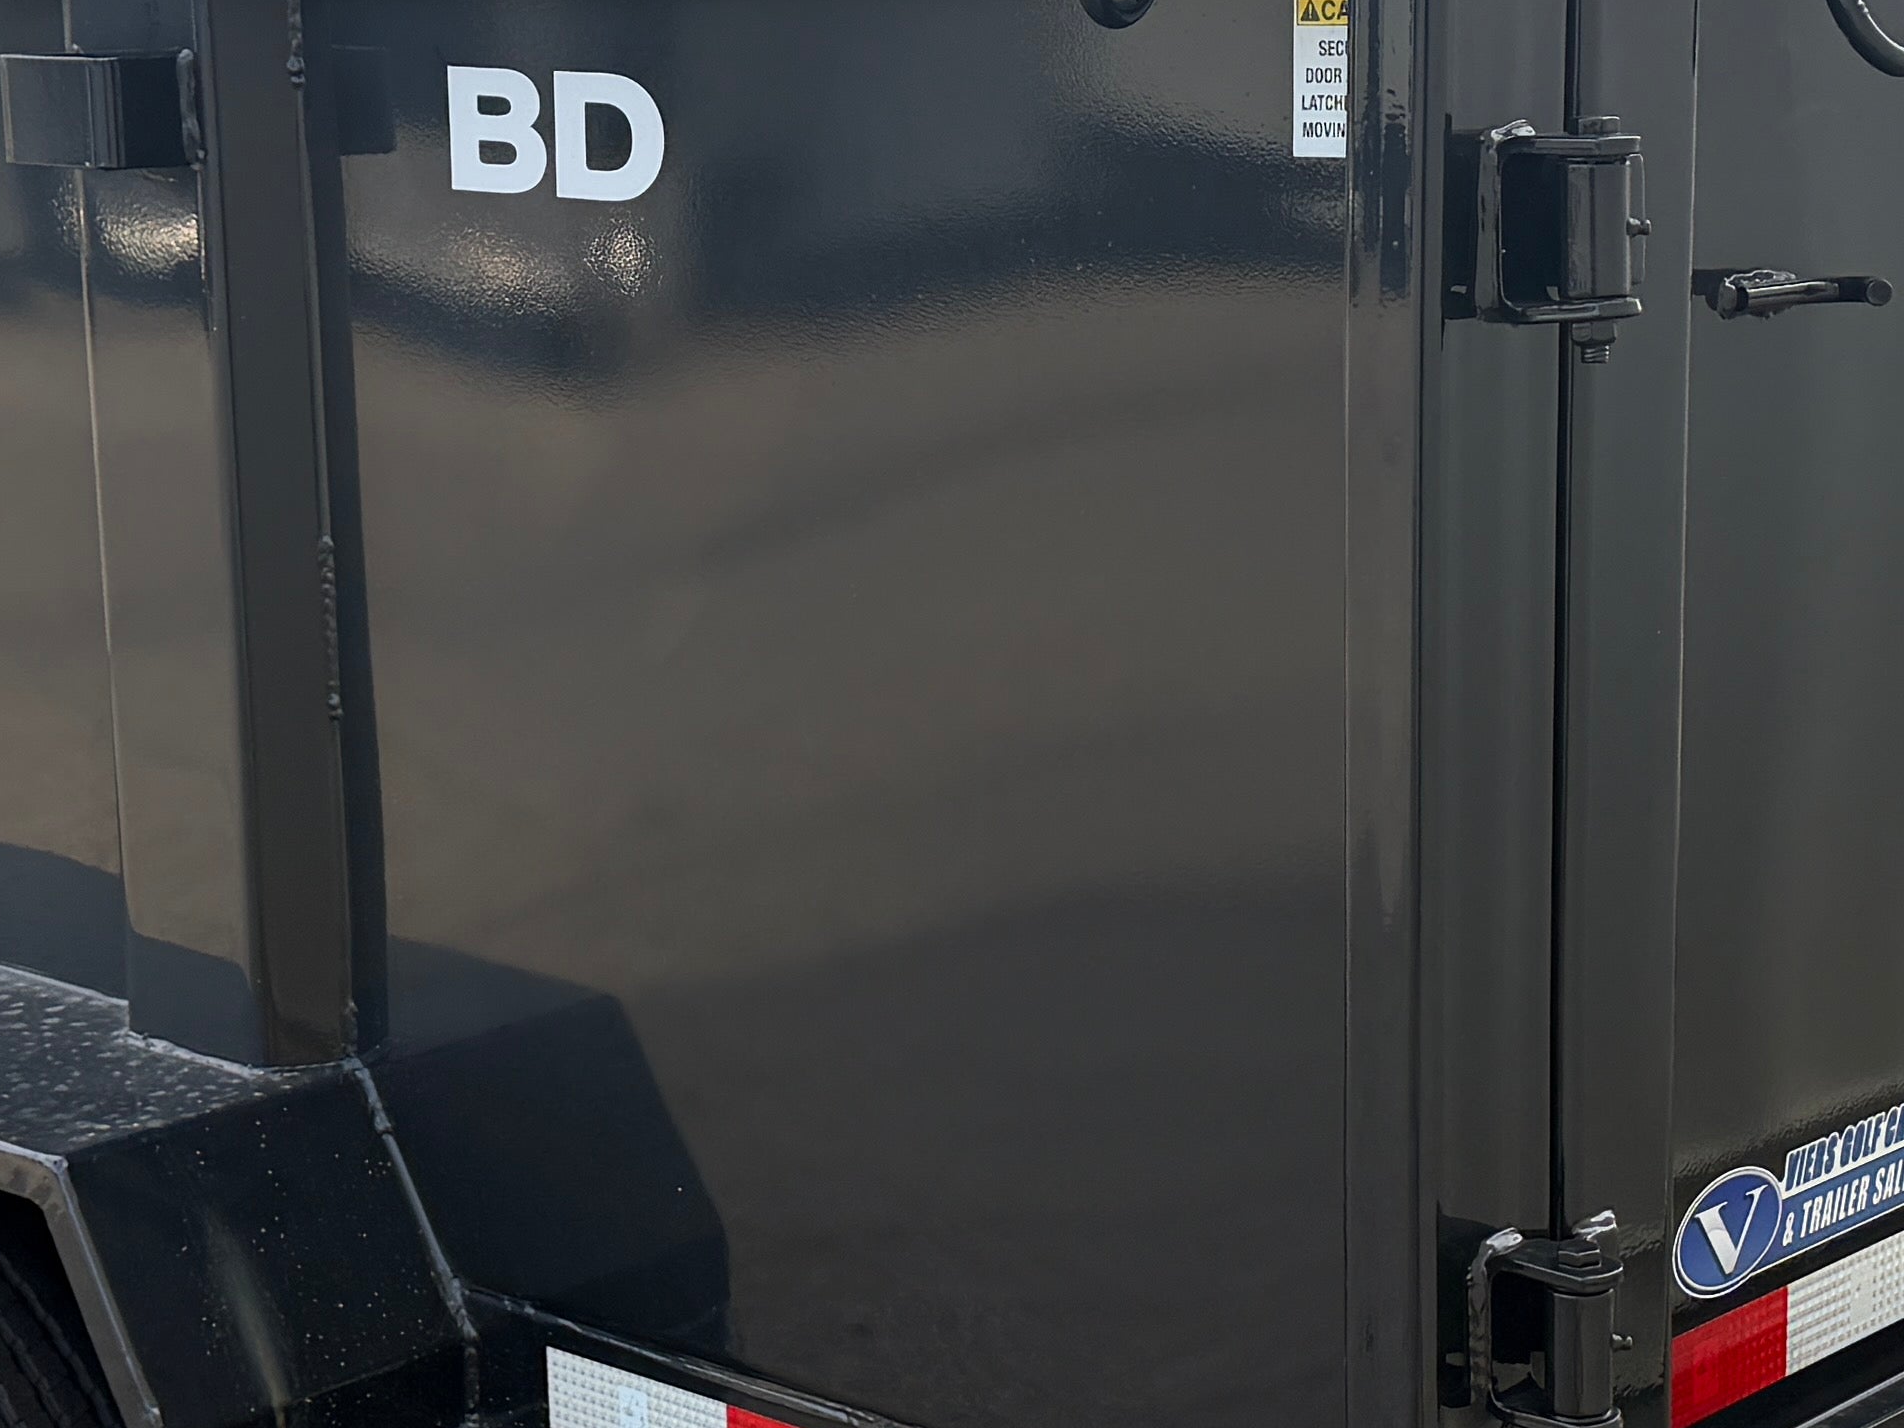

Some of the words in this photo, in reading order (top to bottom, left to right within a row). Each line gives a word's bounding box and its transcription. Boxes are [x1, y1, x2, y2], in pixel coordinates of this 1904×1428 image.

[1318, 39, 1348, 57] SEC
[1305, 67, 1343, 84] DOOR
[1301, 94, 1347, 111] LATCH
[447, 65, 665, 201] BD
[1302, 121, 1346, 139] MOVIN
[1785, 1132, 1840, 1192] VIERS
[1839, 1113, 1886, 1169] GOLF
[1695, 1184, 1769, 1275] V
[1782, 1211, 1795, 1247] &
[1800, 1174, 1871, 1239] TRAILER
